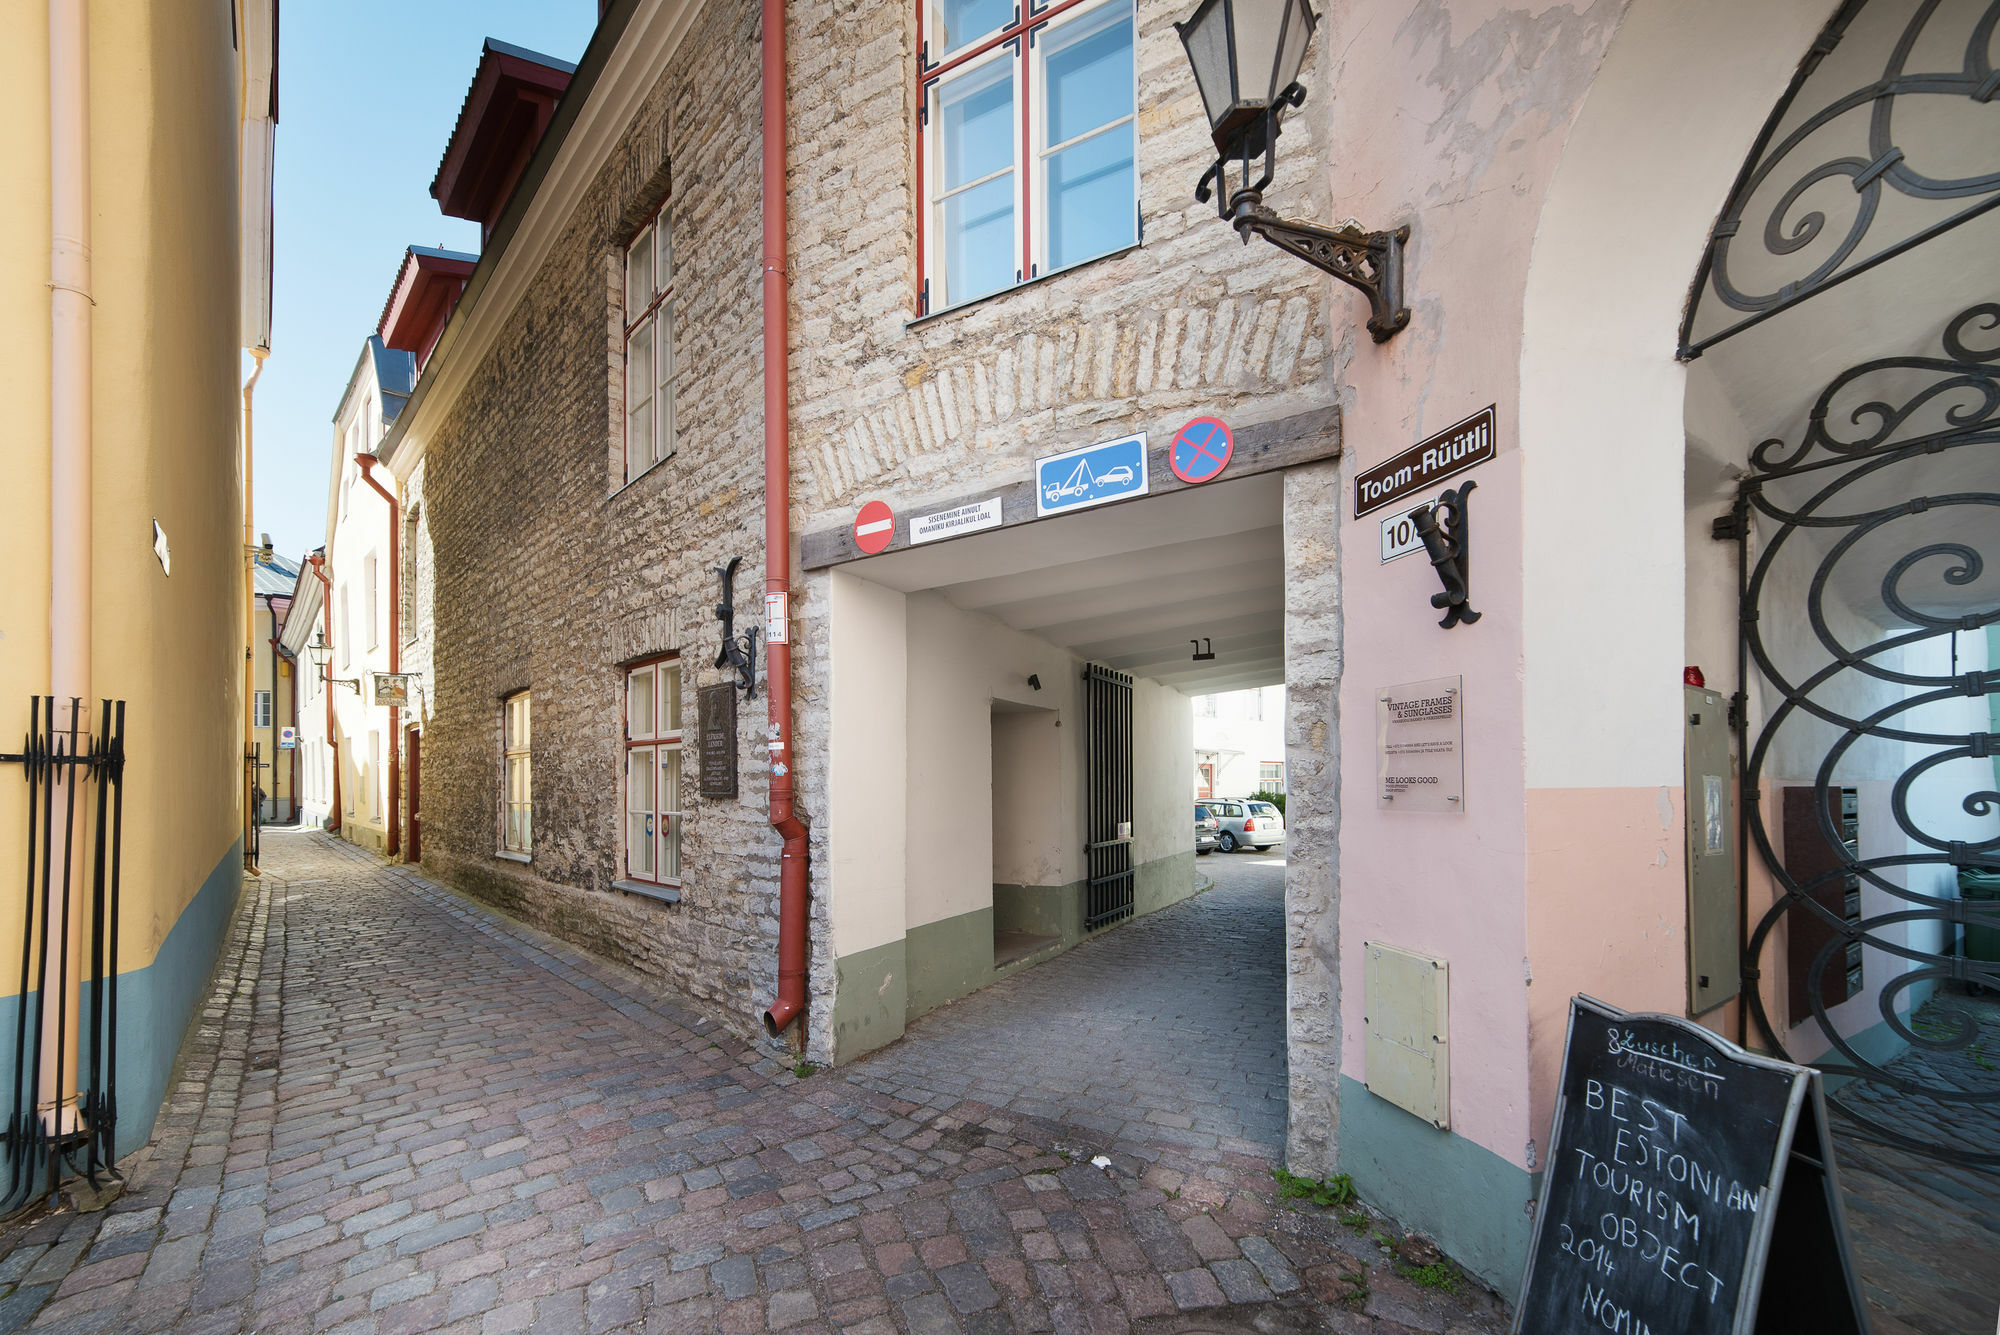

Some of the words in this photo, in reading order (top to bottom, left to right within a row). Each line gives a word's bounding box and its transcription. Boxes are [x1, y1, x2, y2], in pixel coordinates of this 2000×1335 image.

[1360, 422, 1488, 503] Toom-Rüütli
[919, 522, 945, 535] OMANIKU
[945, 515, 976, 529] KIRJALIKUL
[977, 511, 991, 521] LOAL
[928, 509, 960, 524] SISENEMINE
[961, 504, 982, 516] AINULT
[1387, 700, 1420, 711] VINTAGE
[1421, 696, 1452, 707] FRAMES
[1397, 710, 1403, 719] &
[1404, 705, 1453, 718] SUNGLASSES
[1385, 776, 1395, 784] ME
[1396, 776, 1416, 784] LOOKS
[1417, 776, 1438, 784] GOOD
[1585, 1079, 1688, 1143] BEST
[1575, 1148, 1700, 1245] TOURISM
[1614, 1128, 1759, 1212] ESTONIAN
[1560, 1223, 1615, 1276] 2014
[1601, 1212, 1725, 1304] OBJECT
